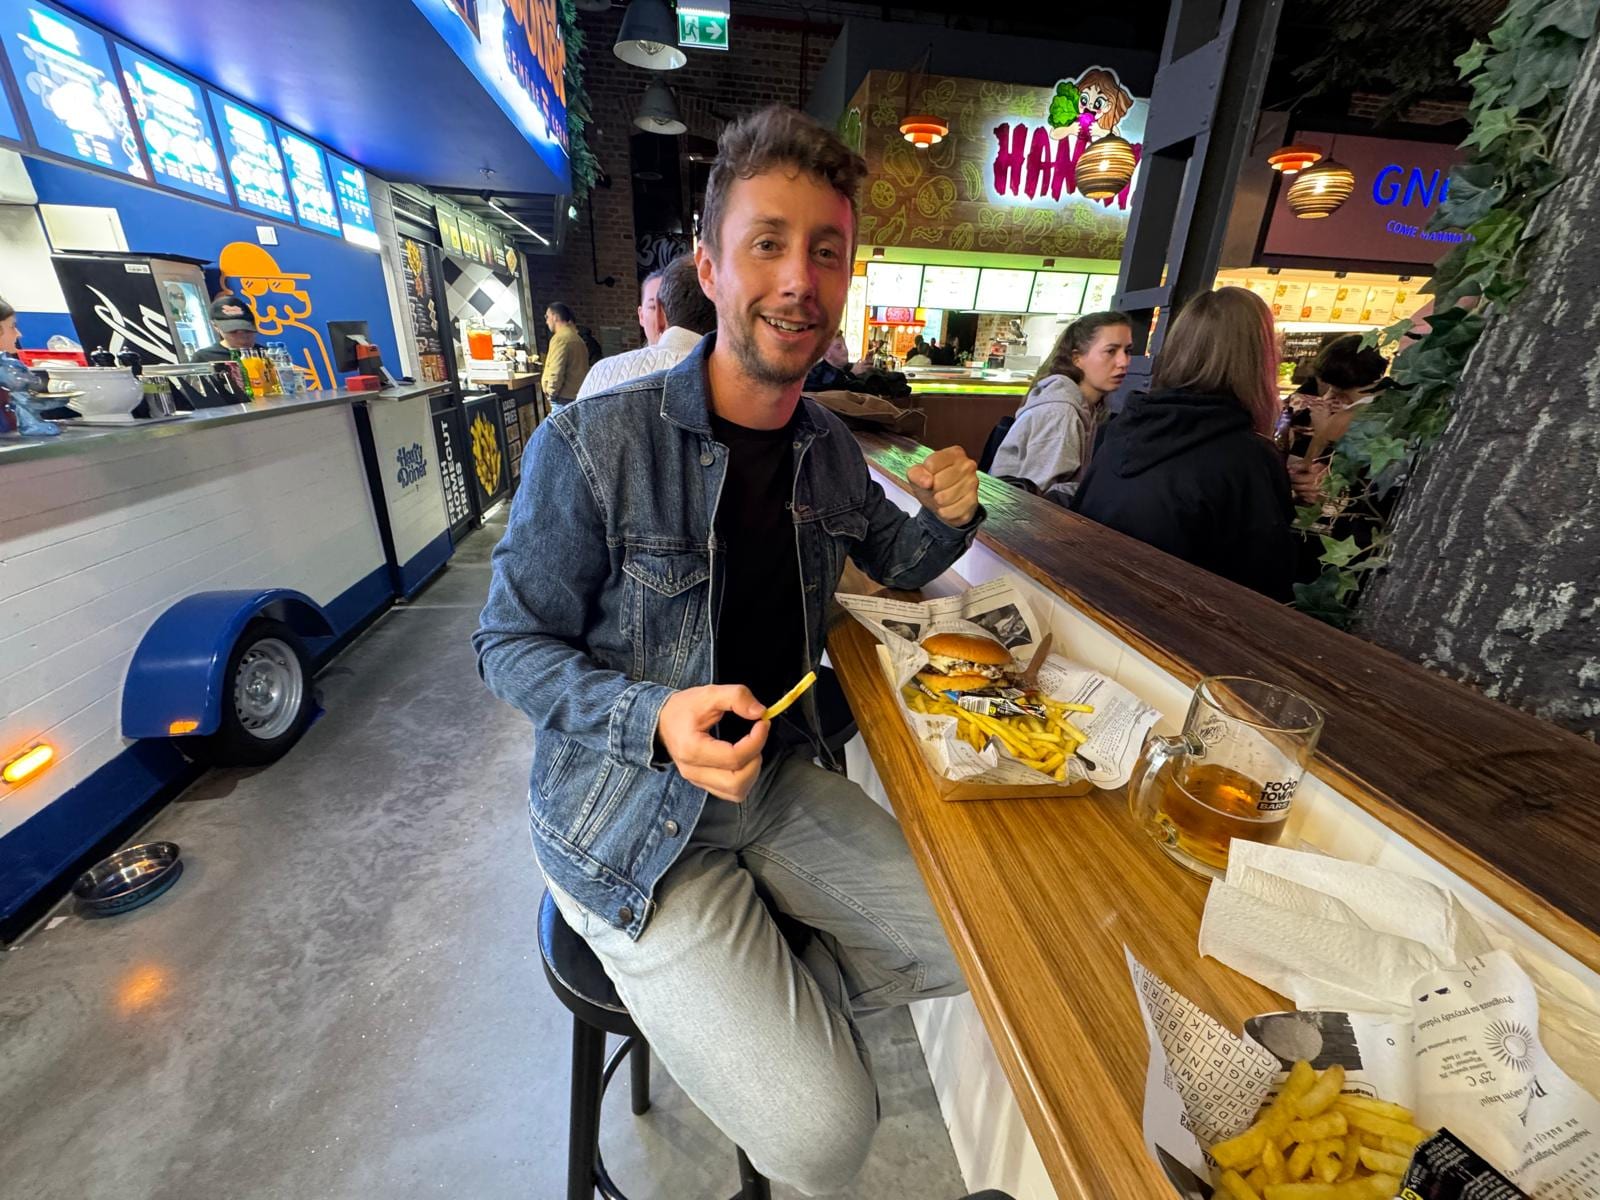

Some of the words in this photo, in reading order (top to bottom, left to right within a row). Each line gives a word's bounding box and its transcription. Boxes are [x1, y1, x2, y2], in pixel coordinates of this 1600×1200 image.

[1386, 219, 1419, 238] COME
[398, 459, 427, 488] Döner
[441, 420, 463, 520] HOMECUT
[441, 461, 457, 525] FRESH
[455, 461, 469, 515] FRIES
[1260, 791, 1295, 801] TOWN
[1264, 781, 1298, 791] FOOD
[1465, 1075, 1477, 1087] C
